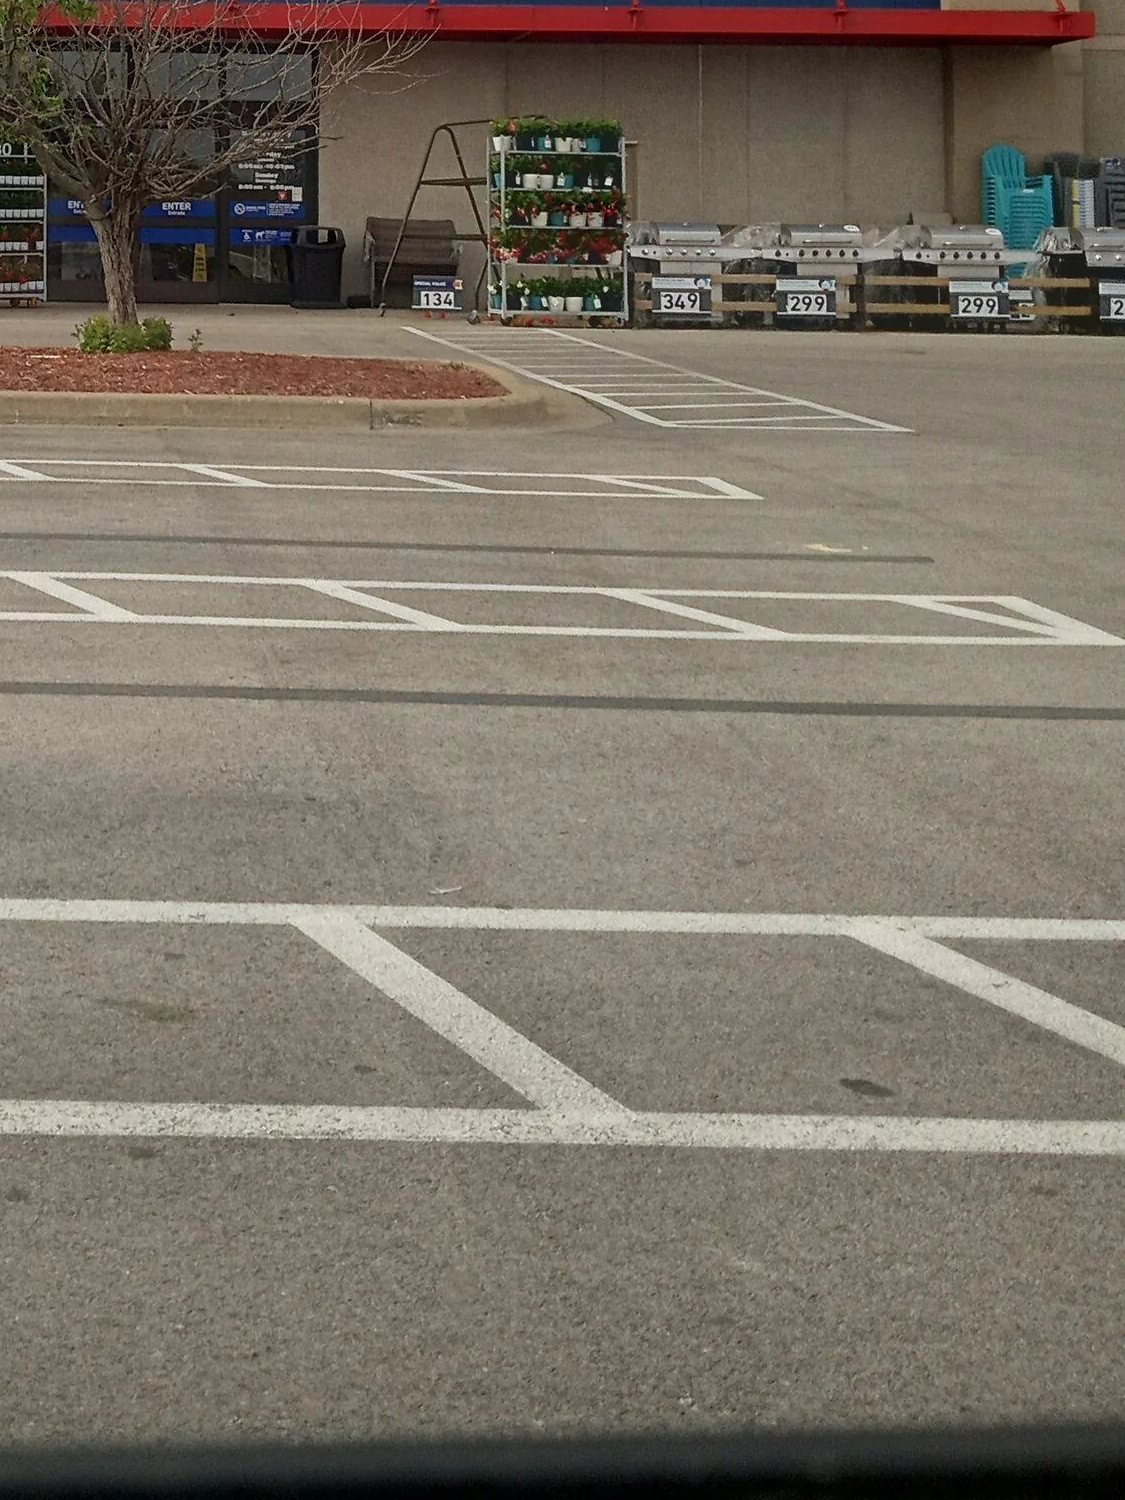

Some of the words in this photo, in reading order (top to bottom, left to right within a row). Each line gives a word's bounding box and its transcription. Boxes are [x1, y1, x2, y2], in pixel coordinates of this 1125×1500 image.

[162, 202, 191, 210] ENTER
[424, 293, 452, 306] 134
[663, 293, 698, 310] 349
[790, 295, 825, 312] 299
[961, 297, 996, 314] 299
